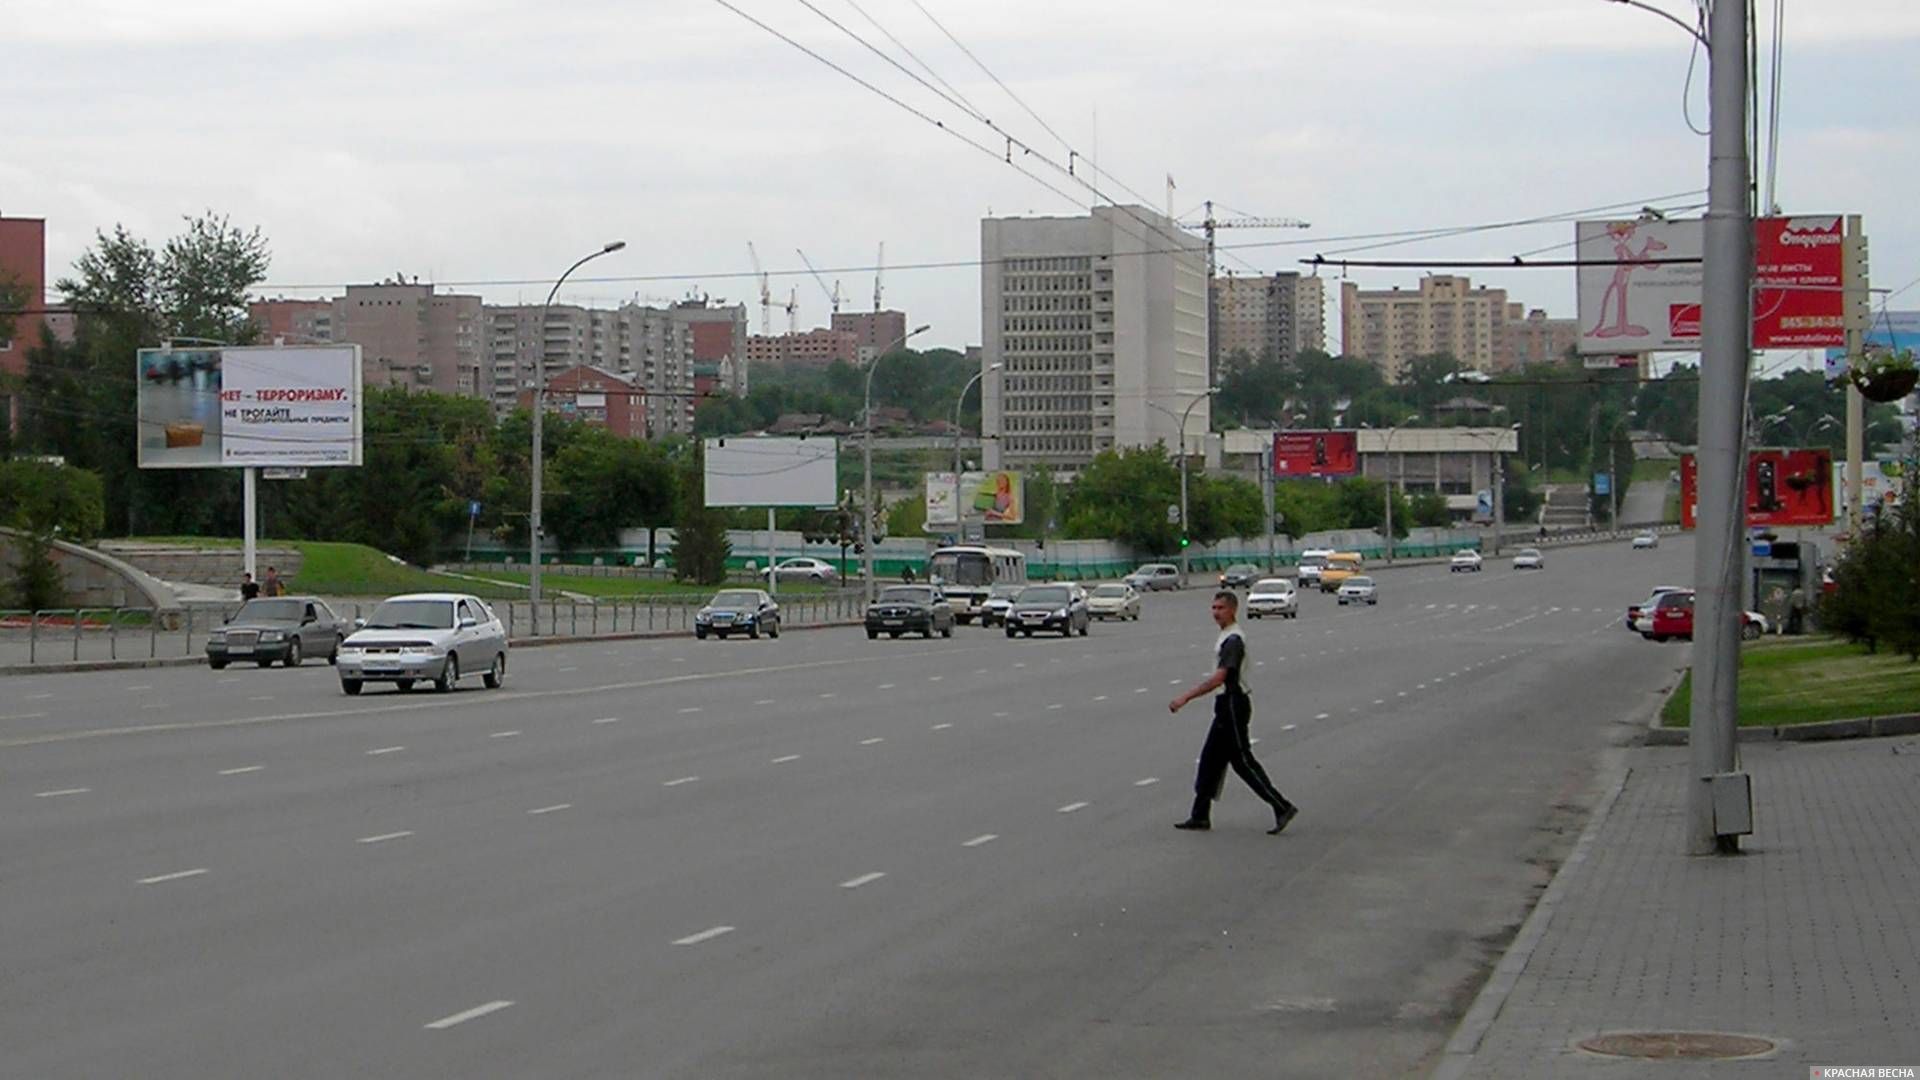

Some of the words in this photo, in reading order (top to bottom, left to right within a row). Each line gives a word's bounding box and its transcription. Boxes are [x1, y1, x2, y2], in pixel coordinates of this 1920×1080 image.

[219, 390, 242, 401] НЕТ
[256, 388, 348, 402] ТЕРРОРИЗМУ.
[224, 409, 237, 418] НЕ
[240, 407, 290, 419] ТРОГАЙТЕ
